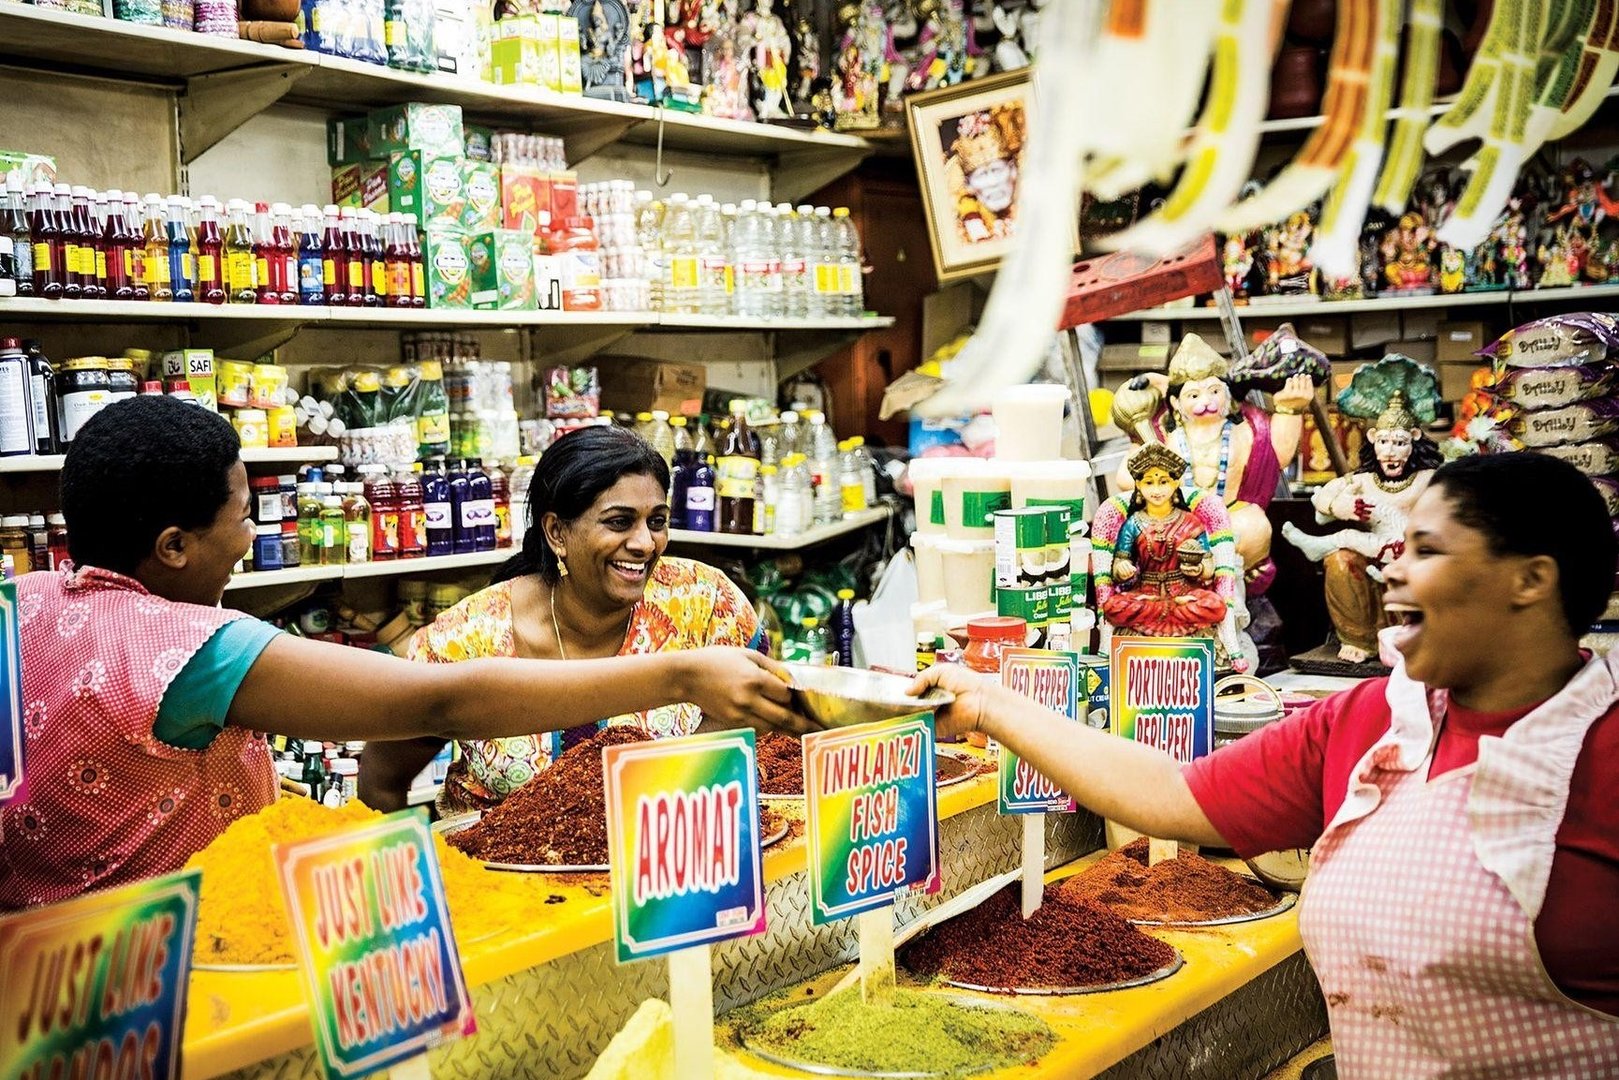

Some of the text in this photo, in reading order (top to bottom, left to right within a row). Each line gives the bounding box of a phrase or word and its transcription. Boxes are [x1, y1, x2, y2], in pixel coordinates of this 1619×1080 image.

[190, 360, 211, 372] SAFI
[1033, 667, 1069, 707] PEPPER
[1128, 657, 1200, 708] PORTUGUESE
[822, 732, 921, 796] INHLANZI
[1136, 715, 1193, 763] PERI-PERI
[851, 787, 898, 841] FISH
[635, 784, 740, 904] AROMAT
[846, 839, 906, 895] SPICE
[312, 842, 426, 950] JUST LIKE
[17, 915, 174, 1045] JUST LIKE
[330, 928, 448, 1049] KENTUCKY
